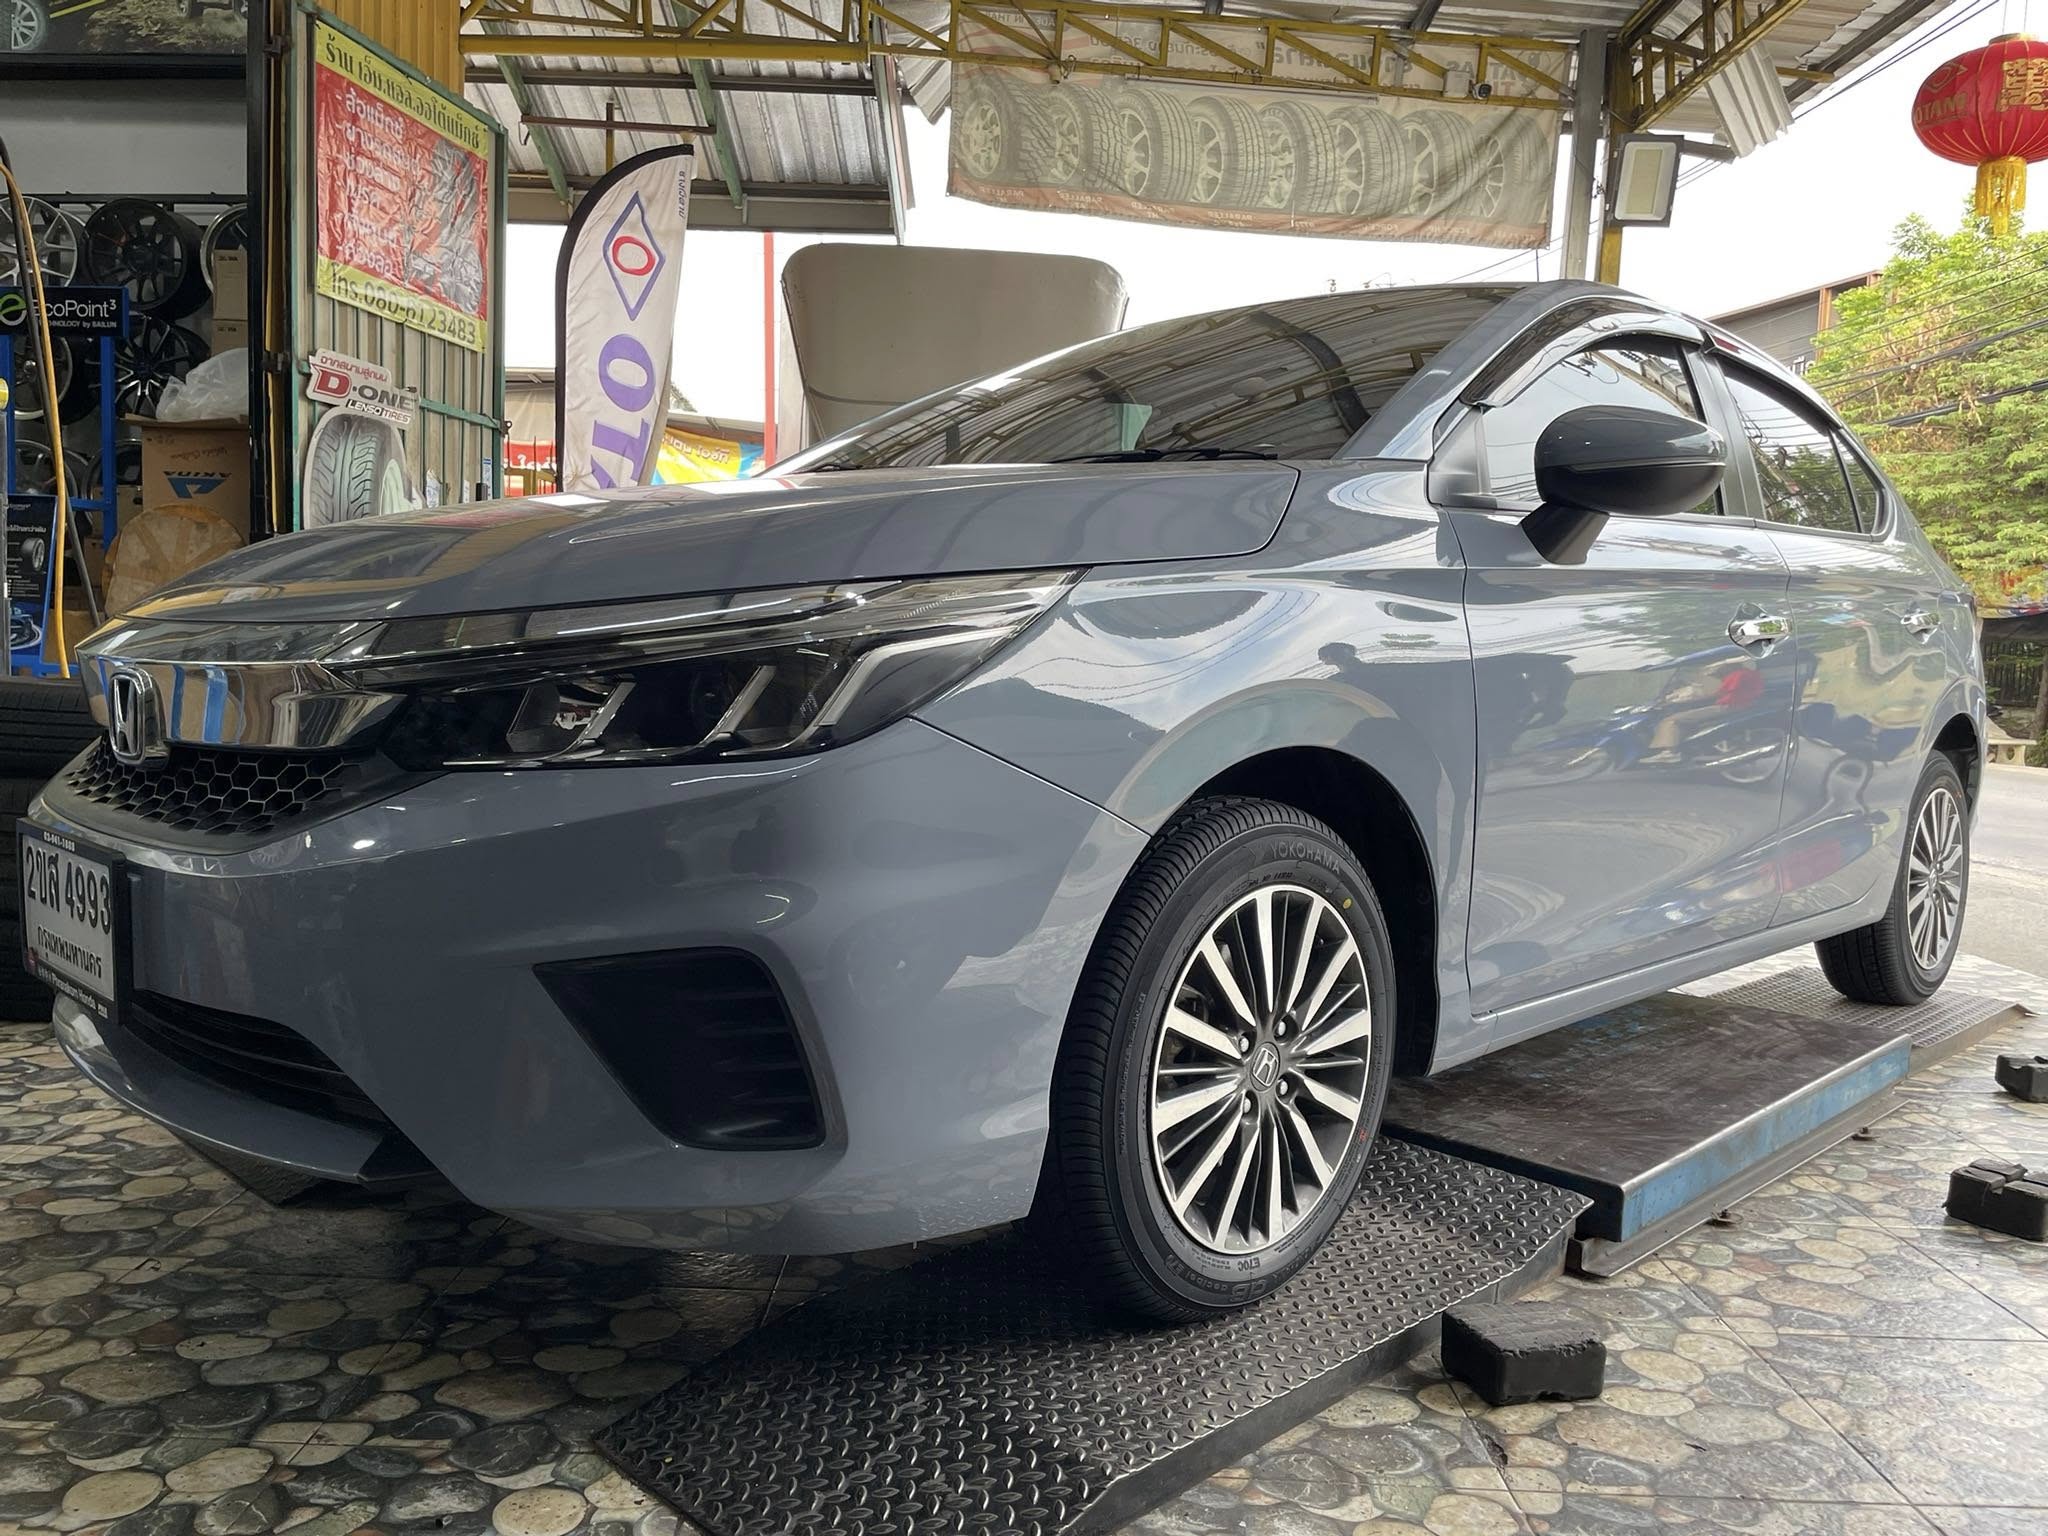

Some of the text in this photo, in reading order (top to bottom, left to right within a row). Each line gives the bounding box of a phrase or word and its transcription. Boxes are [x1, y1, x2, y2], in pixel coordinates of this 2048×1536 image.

[325, 32, 354, 75] ร้าน
[346, 398, 414, 423] LENSO TIRES
[1270, 841, 1341, 874] YOKOHAMA
[64, 860, 111, 936] 4993
[36, 924, 103, 980] กรุงเทพมหานคร
